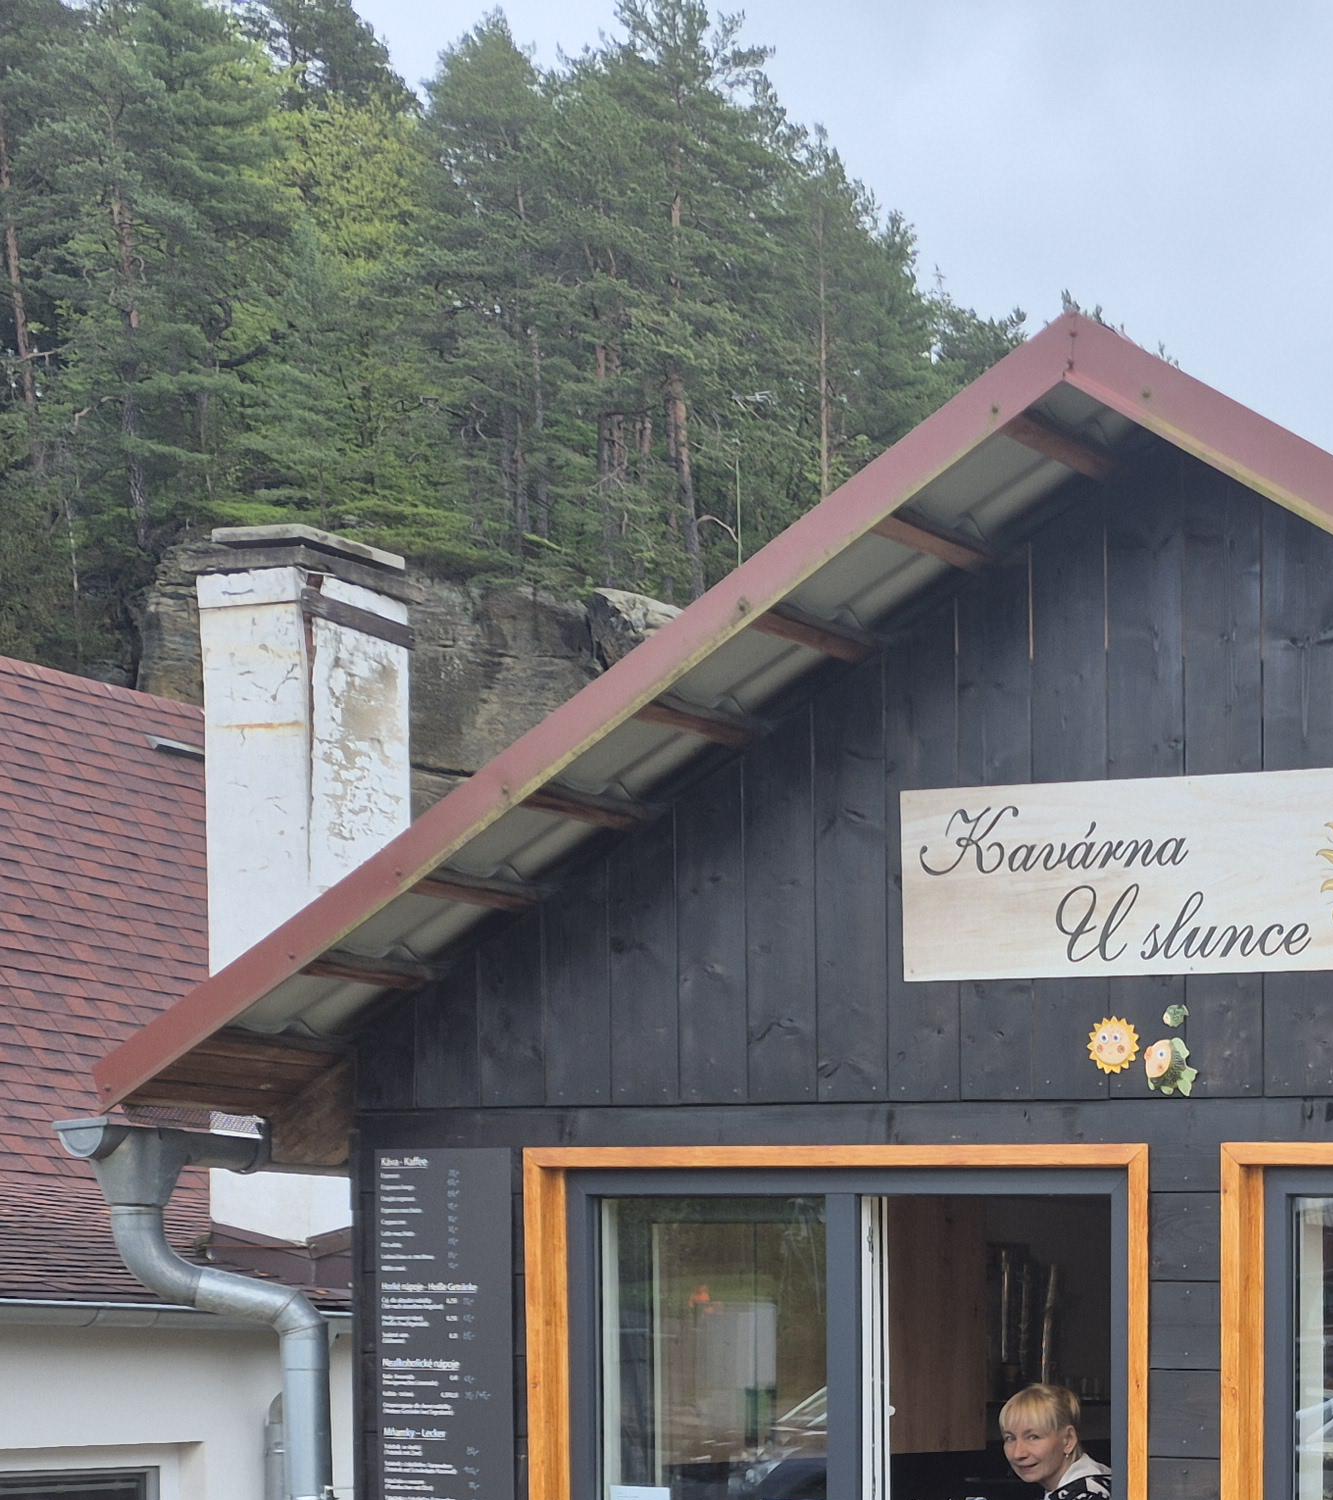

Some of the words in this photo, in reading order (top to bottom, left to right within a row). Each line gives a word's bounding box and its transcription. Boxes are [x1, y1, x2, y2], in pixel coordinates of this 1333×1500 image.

[920, 803, 1191, 878] Kavárna
[1055, 882, 1142, 964] U
[1139, 889, 1313, 962] slunce
